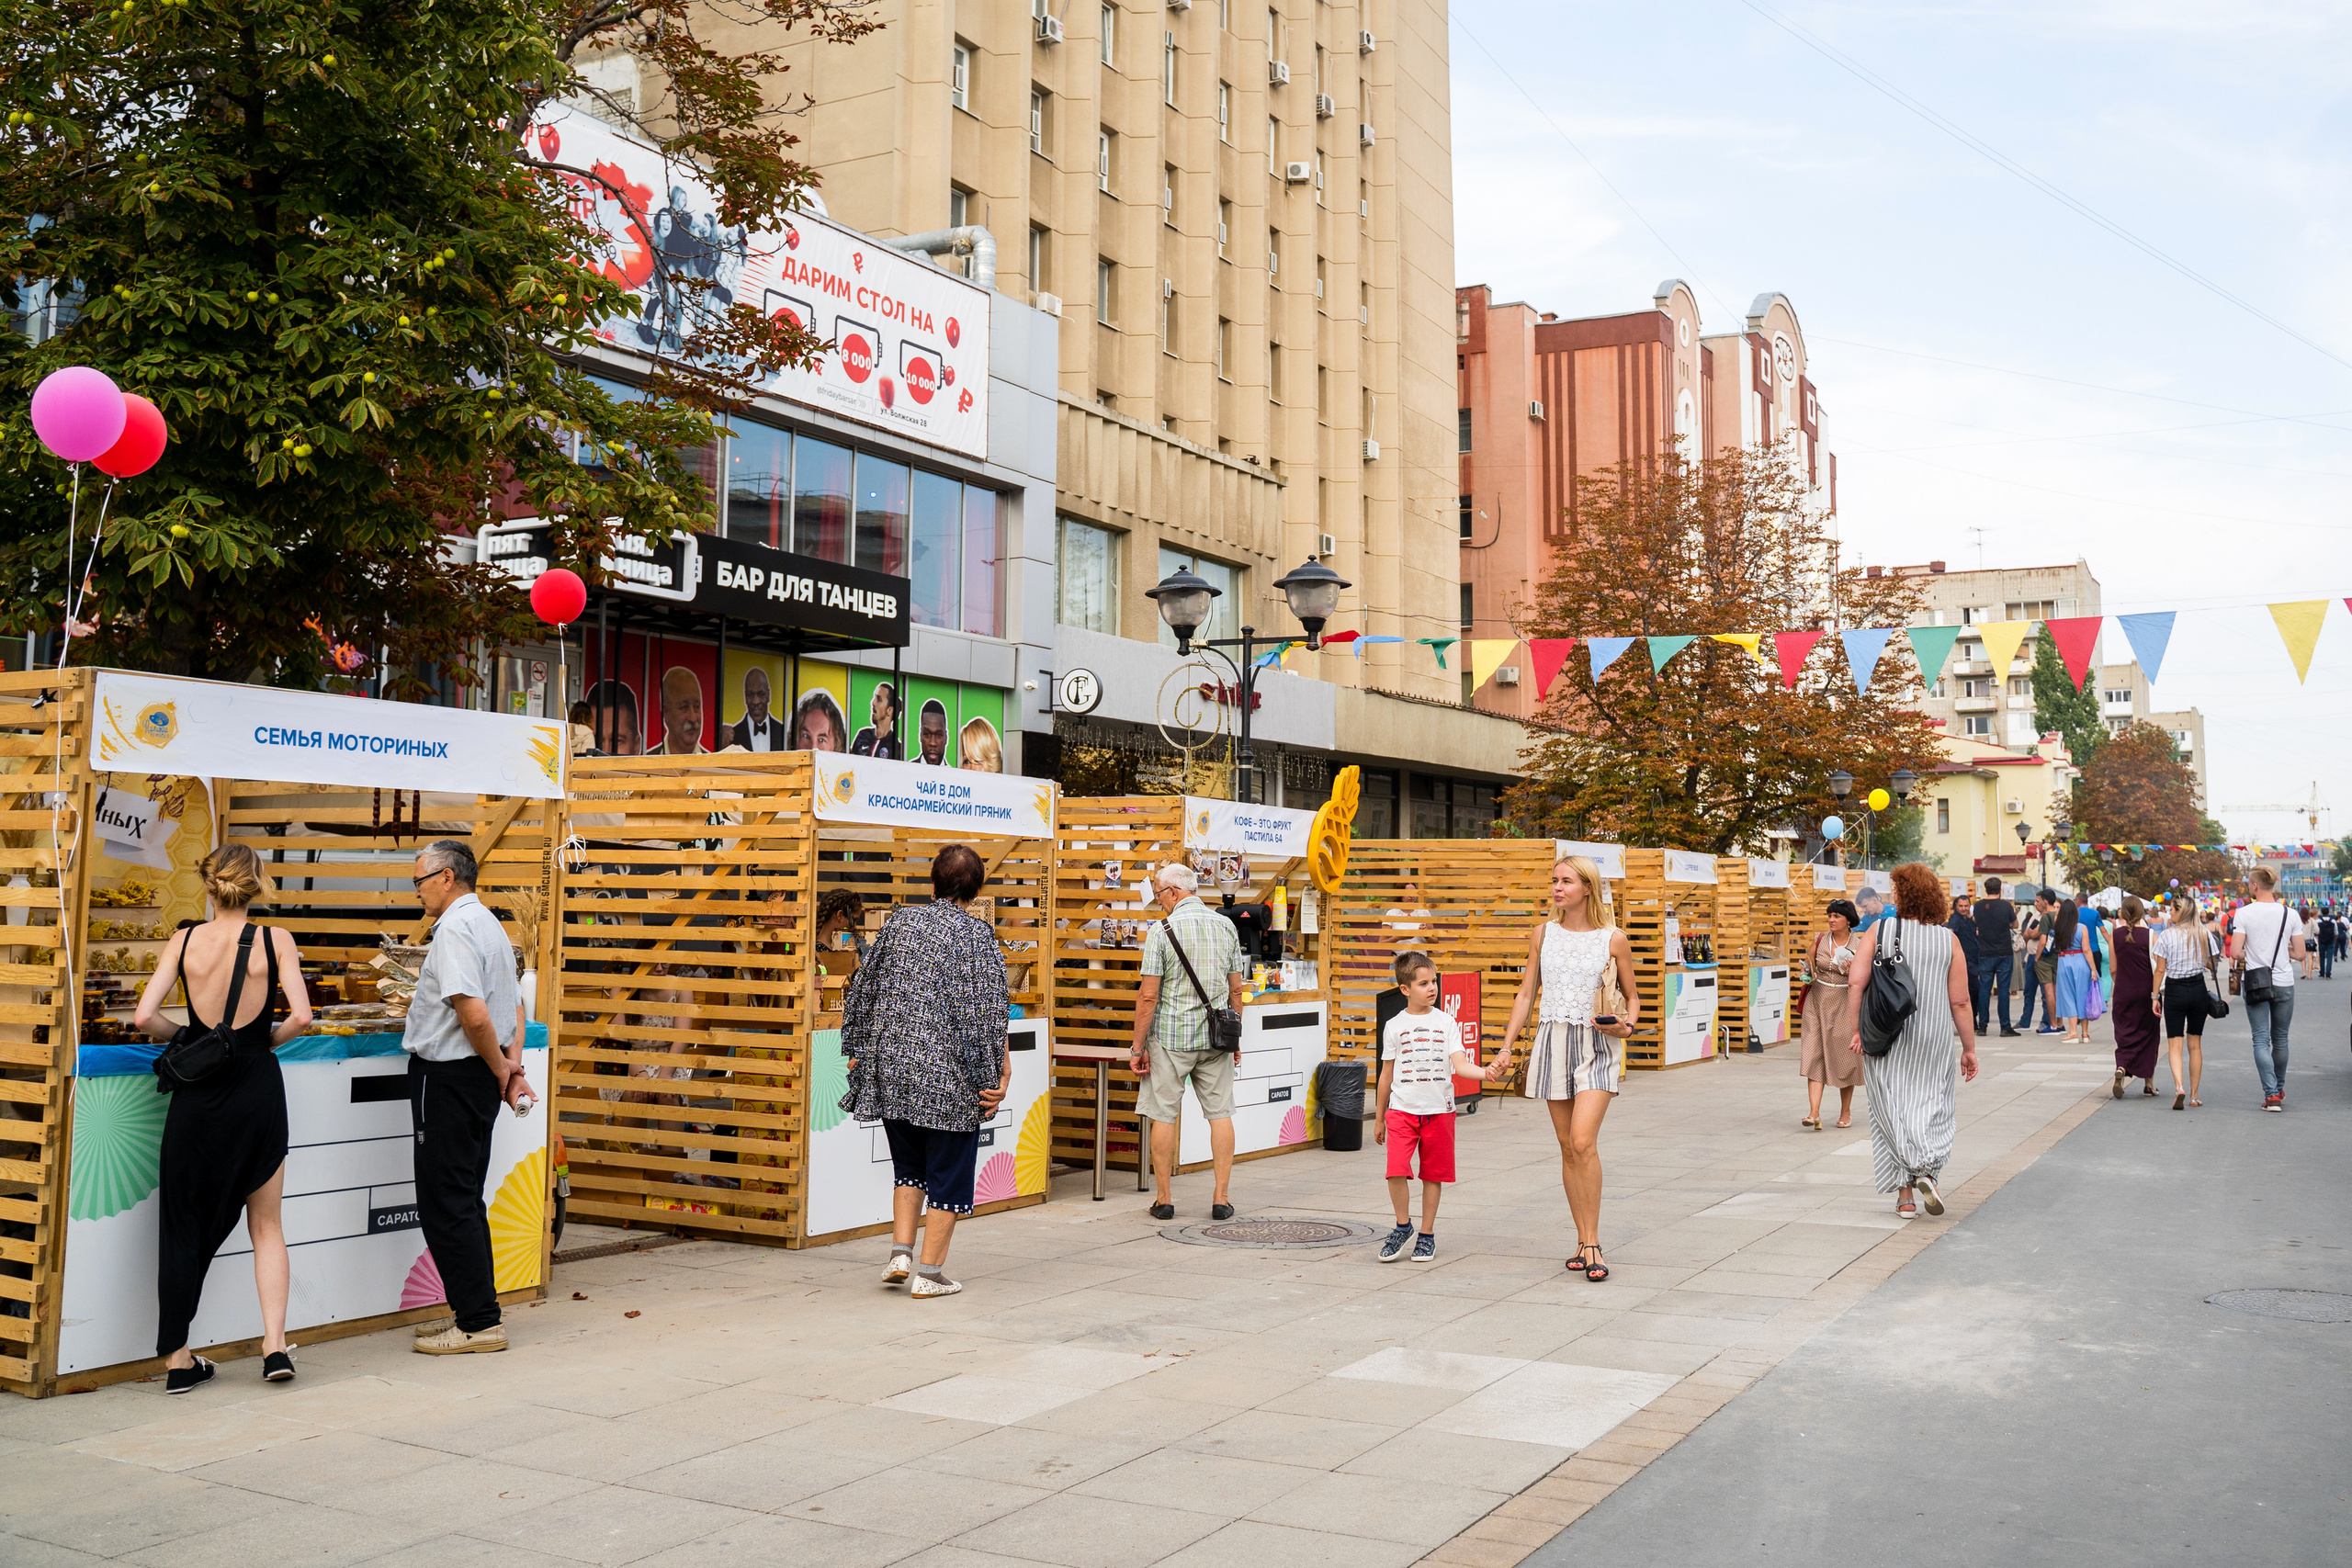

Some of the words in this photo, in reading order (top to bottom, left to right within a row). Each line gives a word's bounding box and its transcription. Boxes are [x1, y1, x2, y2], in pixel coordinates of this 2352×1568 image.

[782, 256, 851, 302] ДАРИМ
[856, 287, 905, 323] СТОЛ
[911, 307, 934, 334] НА
[842, 349, 850, 363] 8
[851, 351, 872, 371] 000
[906, 371, 918, 386] 10
[919, 376, 935, 392] 000
[816, 385, 857, 406] @fridaybarsar
[890, 409, 919, 426] Волжская
[920, 417, 928, 428] 28
[614, 557, 673, 586] ница
[717, 560, 764, 592] БАР
[767, 570, 814, 604] ДЛЯ
[818, 581, 898, 619] ТАНЦЕВ
[254, 726, 322, 749] СЕМЬЯ
[328, 732, 449, 759] МОТОРИНЫХ
[916, 780, 936, 795] ЧАЙ
[939, 784, 946, 795] В
[947, 785, 970, 799] ДОМ
[868, 794, 972, 817] КРАСНОАРМЕЙСКИЙ
[974, 805, 1012, 820] ПРЯНИК
[1234, 815, 1252, 828] КОФЕ
[1258, 818, 1272, 829] ЭТО
[1272, 820, 1292, 831] ФРУКТ
[1244, 830, 1274, 842] ПАСТИЛА
[1274, 834, 1283, 843] 64
[540, 837, 552, 922] WWW.SMCLUSTER.RU
[1271, 1090, 1289, 1100] САРАТОВ
